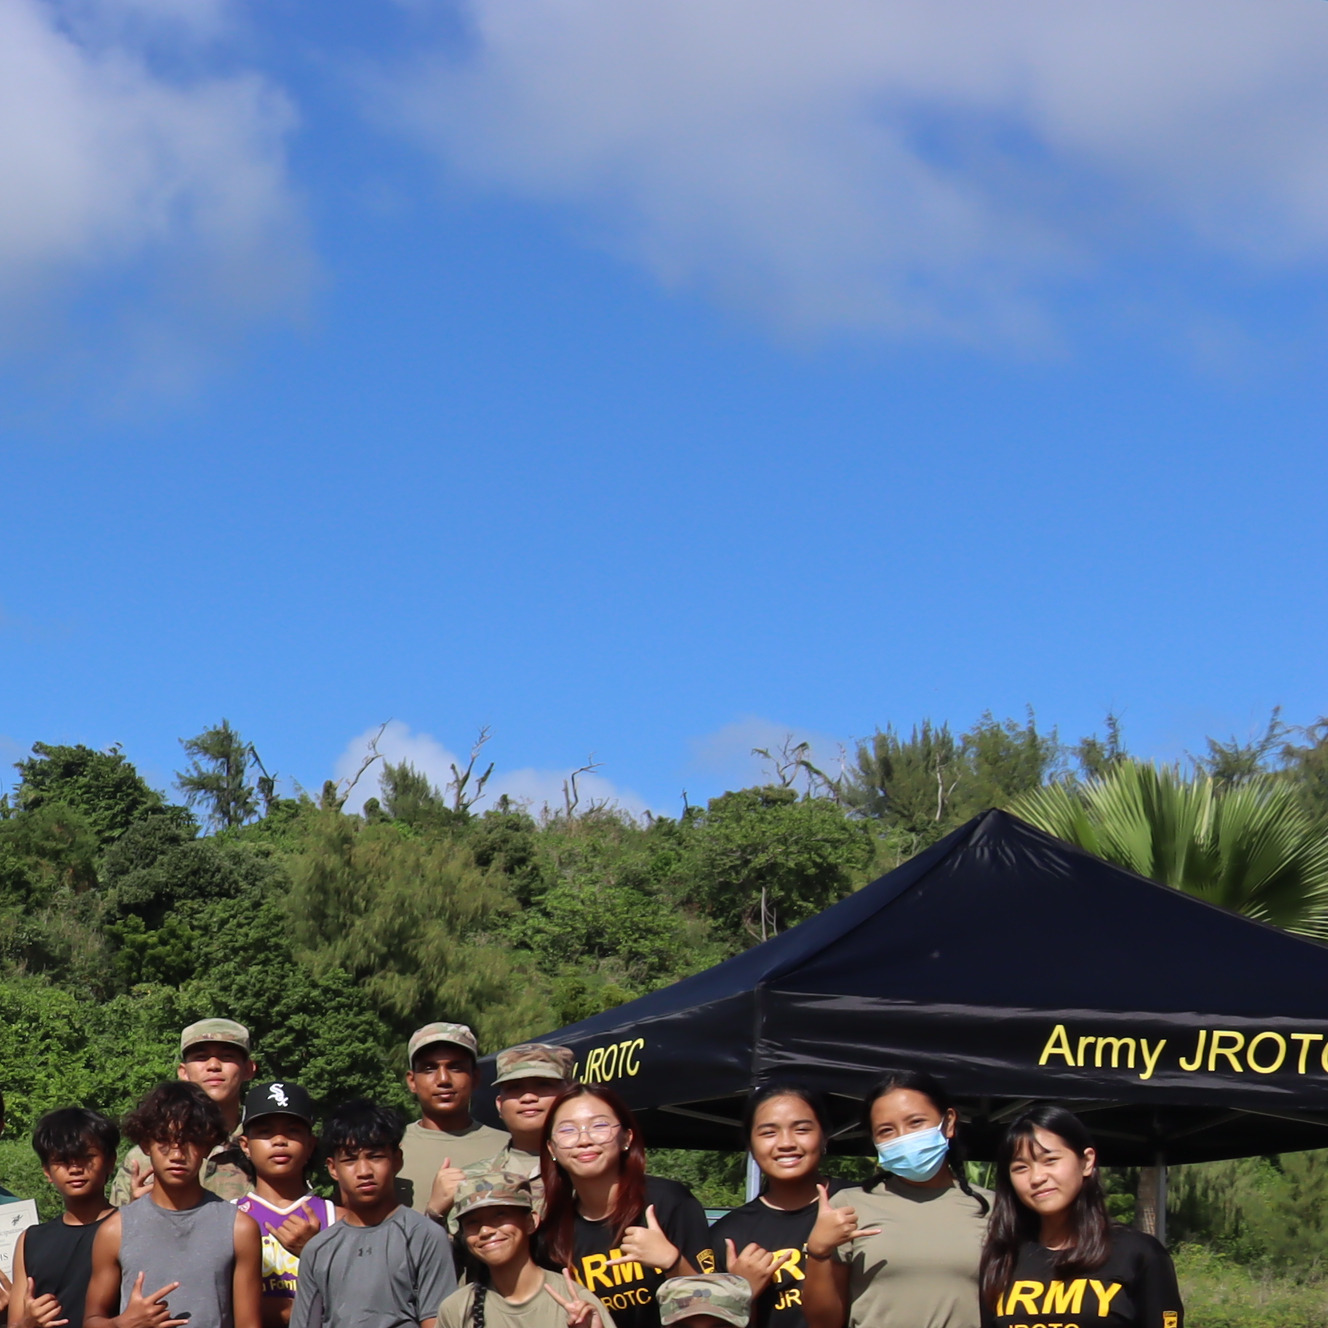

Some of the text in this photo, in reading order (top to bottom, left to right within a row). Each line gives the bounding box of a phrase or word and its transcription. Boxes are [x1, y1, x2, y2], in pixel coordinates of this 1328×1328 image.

[580, 1037, 645, 1085] JROTC
[1038, 1024, 1328, 1080] Army JROT
[600, 1287, 652, 1311] ROTC
